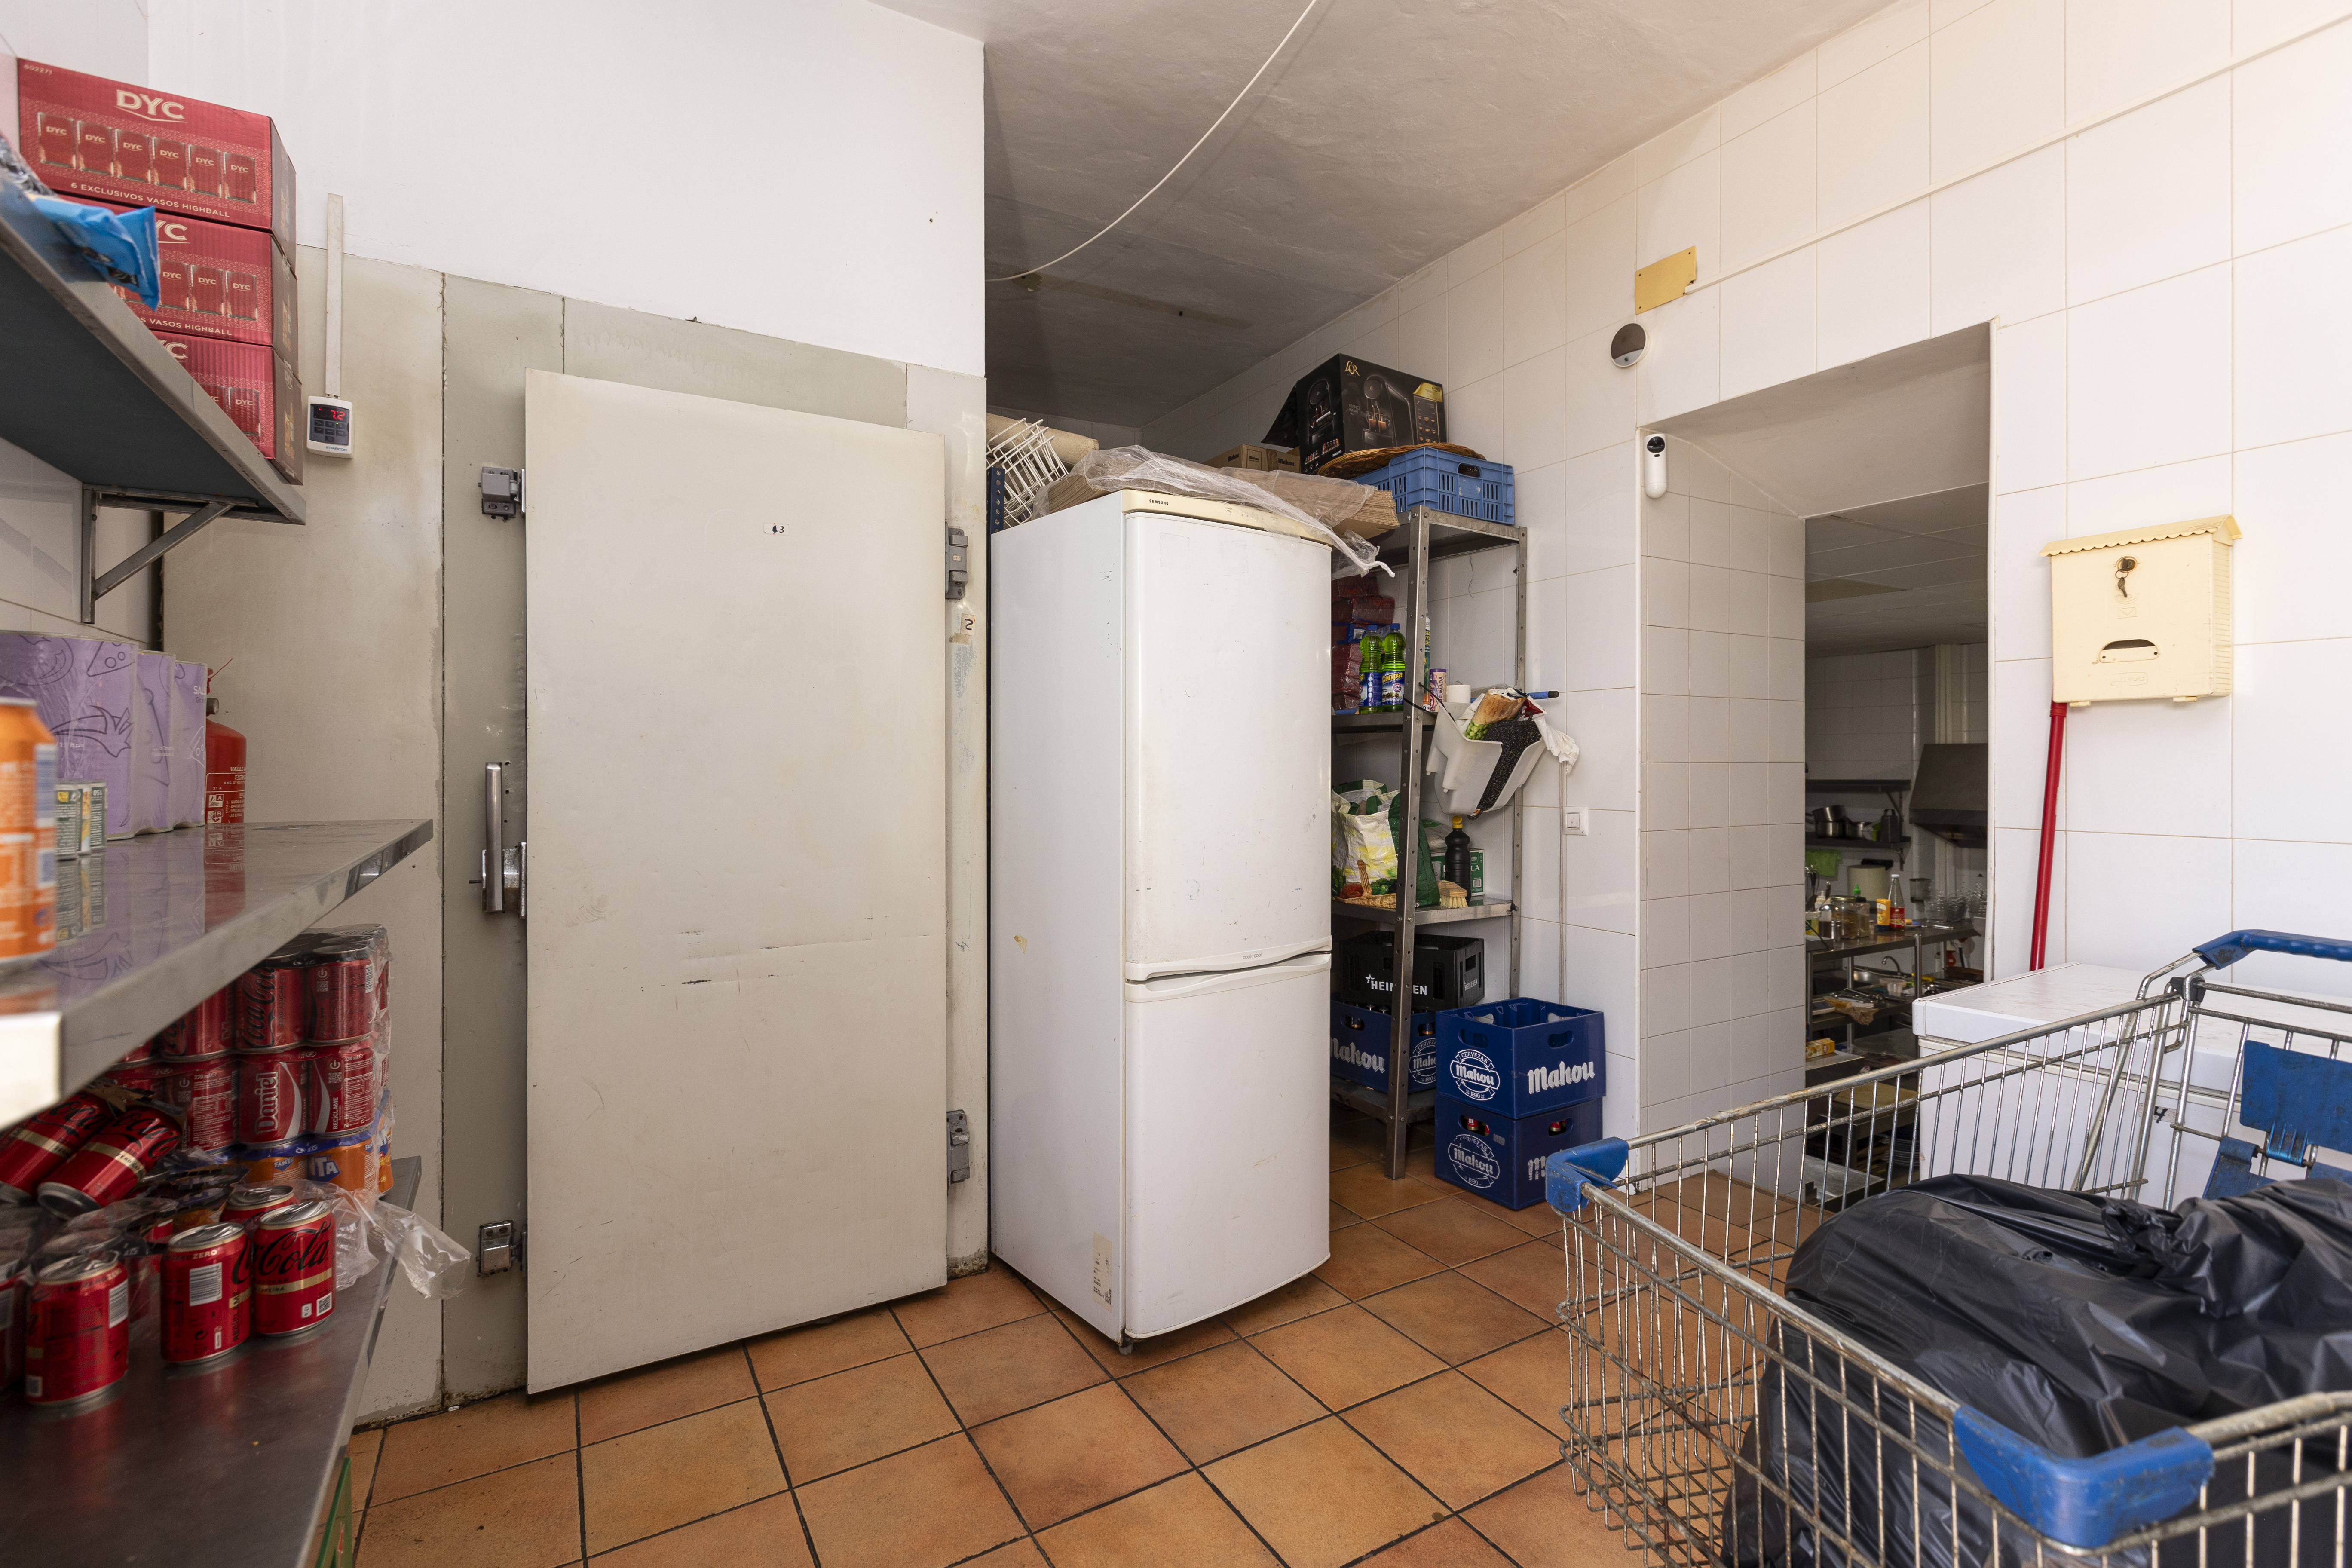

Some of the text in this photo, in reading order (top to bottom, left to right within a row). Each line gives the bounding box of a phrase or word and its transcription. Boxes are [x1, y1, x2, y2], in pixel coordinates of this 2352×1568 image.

[116, 89, 185, 119] DYC
[46, 126, 67, 135] DYC
[86, 135, 106, 143] DYC
[123, 142, 143, 150] DYC
[160, 150, 179, 158] DYC
[196, 157, 214, 165] DYC
[231, 165, 249, 173] DYC
[81, 184, 144, 201] EXCLUSIVOS
[147, 196, 179, 208] VASOS
[182, 203, 230, 217] HIGHBALL
[163, 271, 181, 279] DYC
[150, 318, 181, 328] VASOS
[185, 324, 232, 336] HIGHBALL
[1278, 458, 1295, 466] Mahou
[965, 618, 974, 631] 2
[1371, 981, 1427, 995] HEIEN
[1464, 979, 1478, 991] HEINEKEN
[1418, 1038, 1436, 1050] CERVEZ
[1461, 1051, 1488, 1064] CERVEZAS
[1455, 1064, 1495, 1086] Mahou
[1527, 1061, 1596, 1094] Mahou
[254, 1071, 279, 1135] Daniel
[2153, 1106, 2168, 1124] 4
[1453, 1148, 1494, 1174] Mahou
[192, 1248, 218, 1259] ZERO
